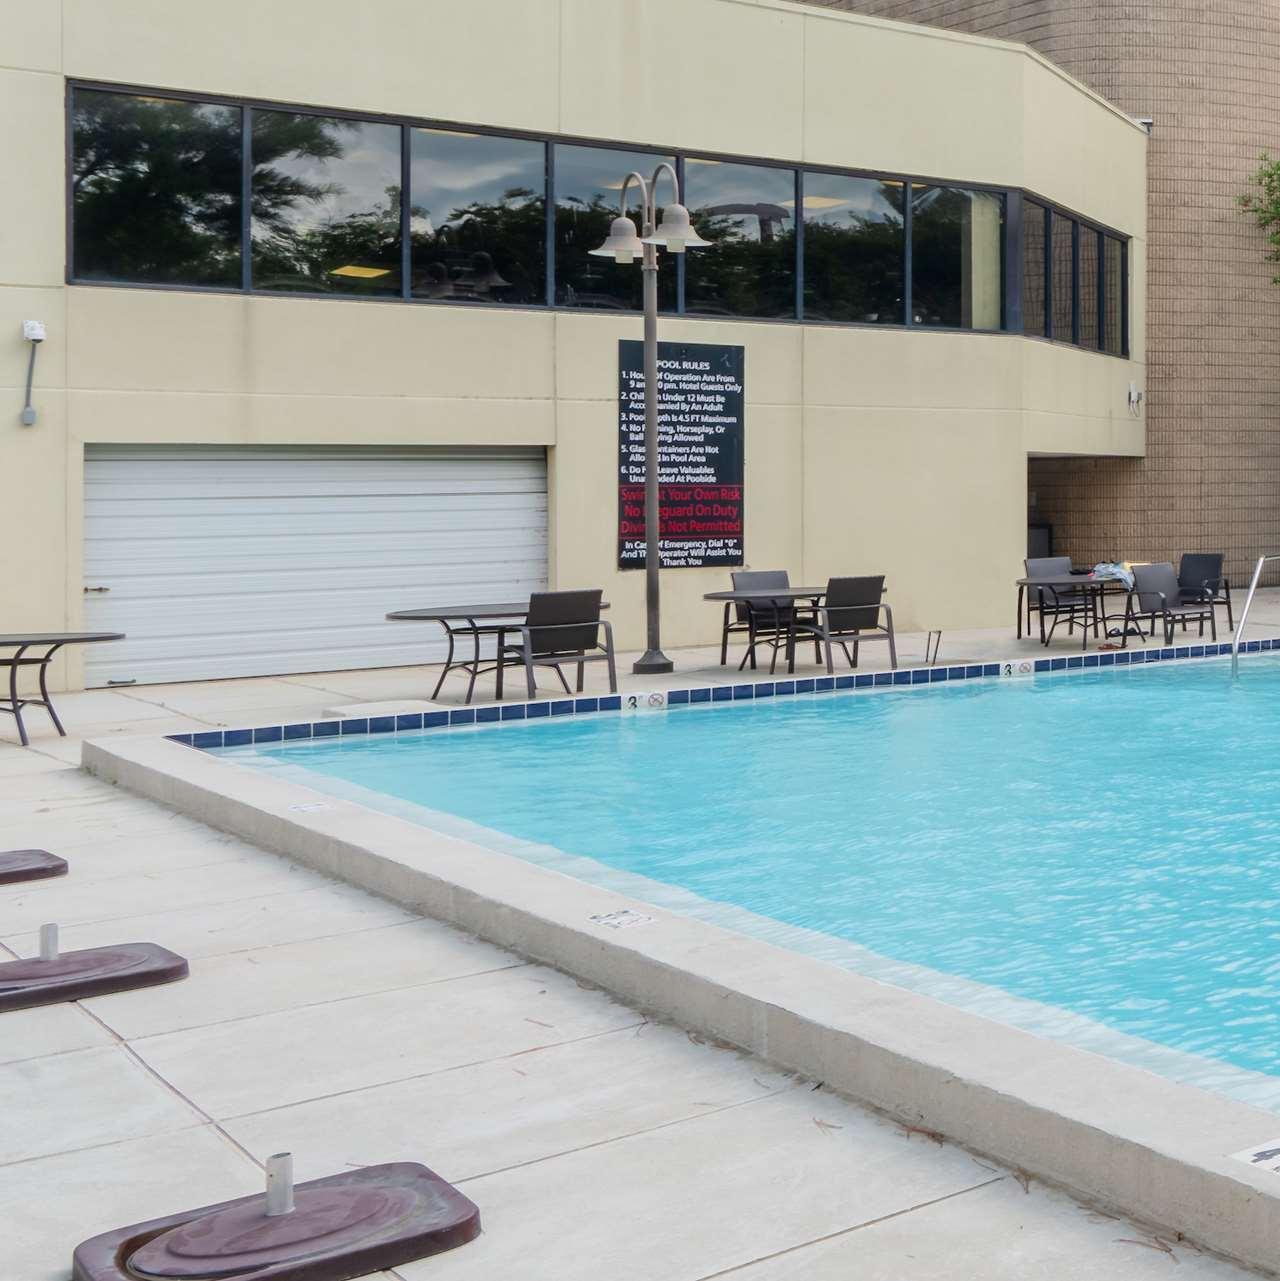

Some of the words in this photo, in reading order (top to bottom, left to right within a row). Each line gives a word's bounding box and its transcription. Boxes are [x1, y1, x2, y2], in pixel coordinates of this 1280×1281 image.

[656, 360, 681, 369] POOL
[682, 361, 711, 370] RULES
[622, 371, 628, 379] 1.
[664, 373, 702, 383] Operation
[702, 374, 716, 382] Are
[716, 374, 735, 383] From
[629, 380, 635, 388] 9
[679, 382, 700, 390] Hotel
[700, 383, 725, 391] Guests
[725, 384, 742, 393] Only
[621, 392, 629, 400] 2.
[662, 393, 686, 401] Under
[687, 394, 696, 402] 12
[696, 394, 715, 402] Must
[715, 395, 725, 403] Be
[680, 402, 690, 412] By
[702, 404, 724, 412] Adult
[621, 413, 629, 421] 3.
[701, 415, 737, 423] Maximum
[629, 424, 641, 432] No
[676, 425, 714, 434] Horseplay,
[629, 432, 644, 441] Ball
[673, 434, 704, 442] Allowed
[621, 445, 629, 453] 5.
[690, 446, 704, 454] Are
[705, 446, 719, 454] Not
[661, 454, 670, 462] In
[670, 454, 688, 462] Pool
[621, 466, 629, 474] 6.
[629, 466, 641, 474] Do
[679, 466, 715, 474] Valuables
[675, 475, 686, 483] At
[686, 475, 717, 483] Poolside
[669, 488, 692, 500] Your
[694, 488, 718, 500] Own
[720, 488, 740, 500] Risk
[624, 505, 640, 517] No
[695, 504, 711, 516] On
[712, 504, 738, 517] Duty
[668, 521, 688, 532] Not
[689, 521, 740, 531] Permitted
[625, 541, 634, 549] In
[664, 540, 707, 549] Emergency,
[708, 539, 724, 547] Dial
[621, 550, 638, 559] And
[690, 549, 705, 557] Will
[705, 548, 727, 557] Assist
[727, 547, 742, 556] You
[663, 558, 687, 566] Thank
[687, 557, 703, 565] You
